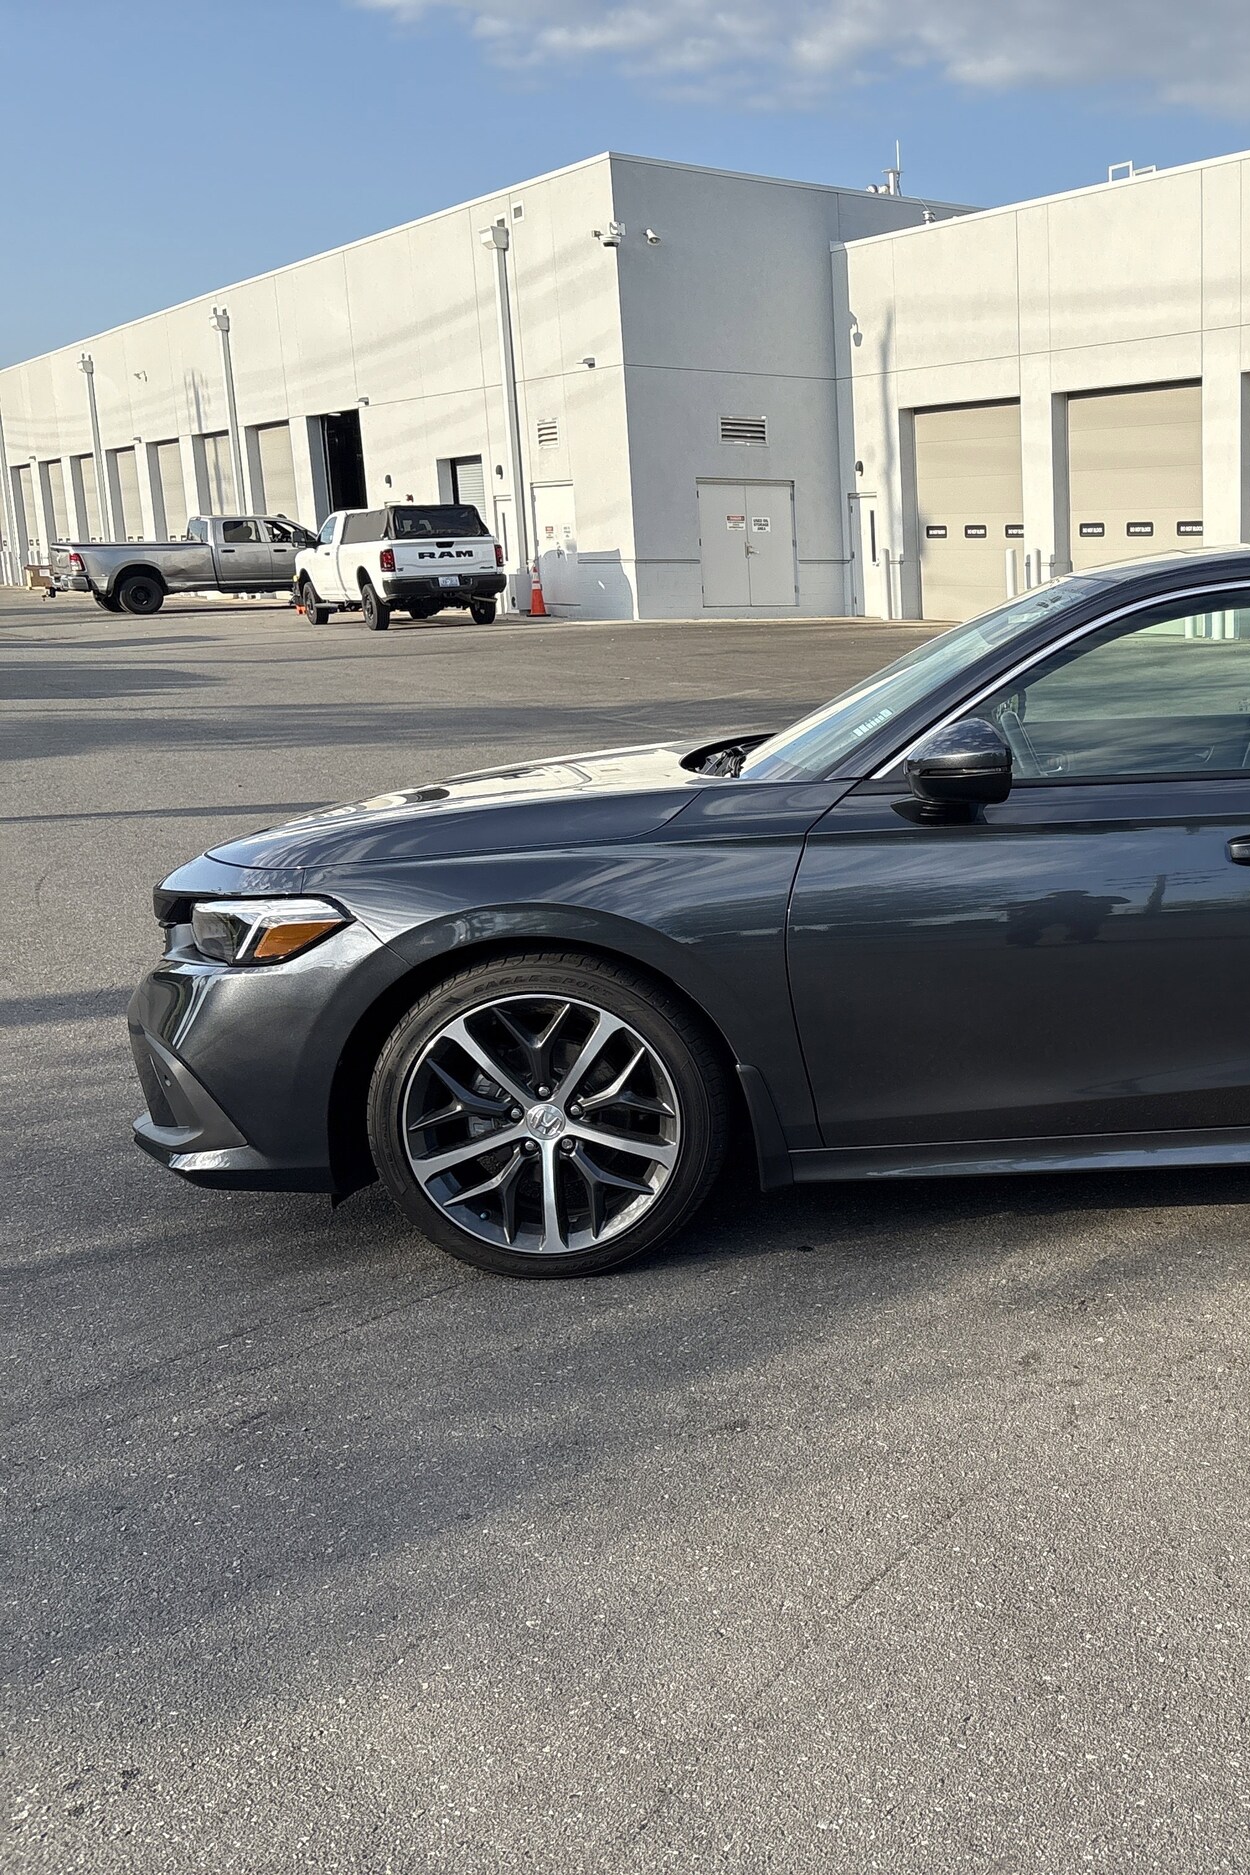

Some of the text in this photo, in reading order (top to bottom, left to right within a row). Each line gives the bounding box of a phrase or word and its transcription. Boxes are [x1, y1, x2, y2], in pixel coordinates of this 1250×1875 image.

[418, 550, 474, 559] RAM
[473, 974, 615, 996] EAGLE SPORT
